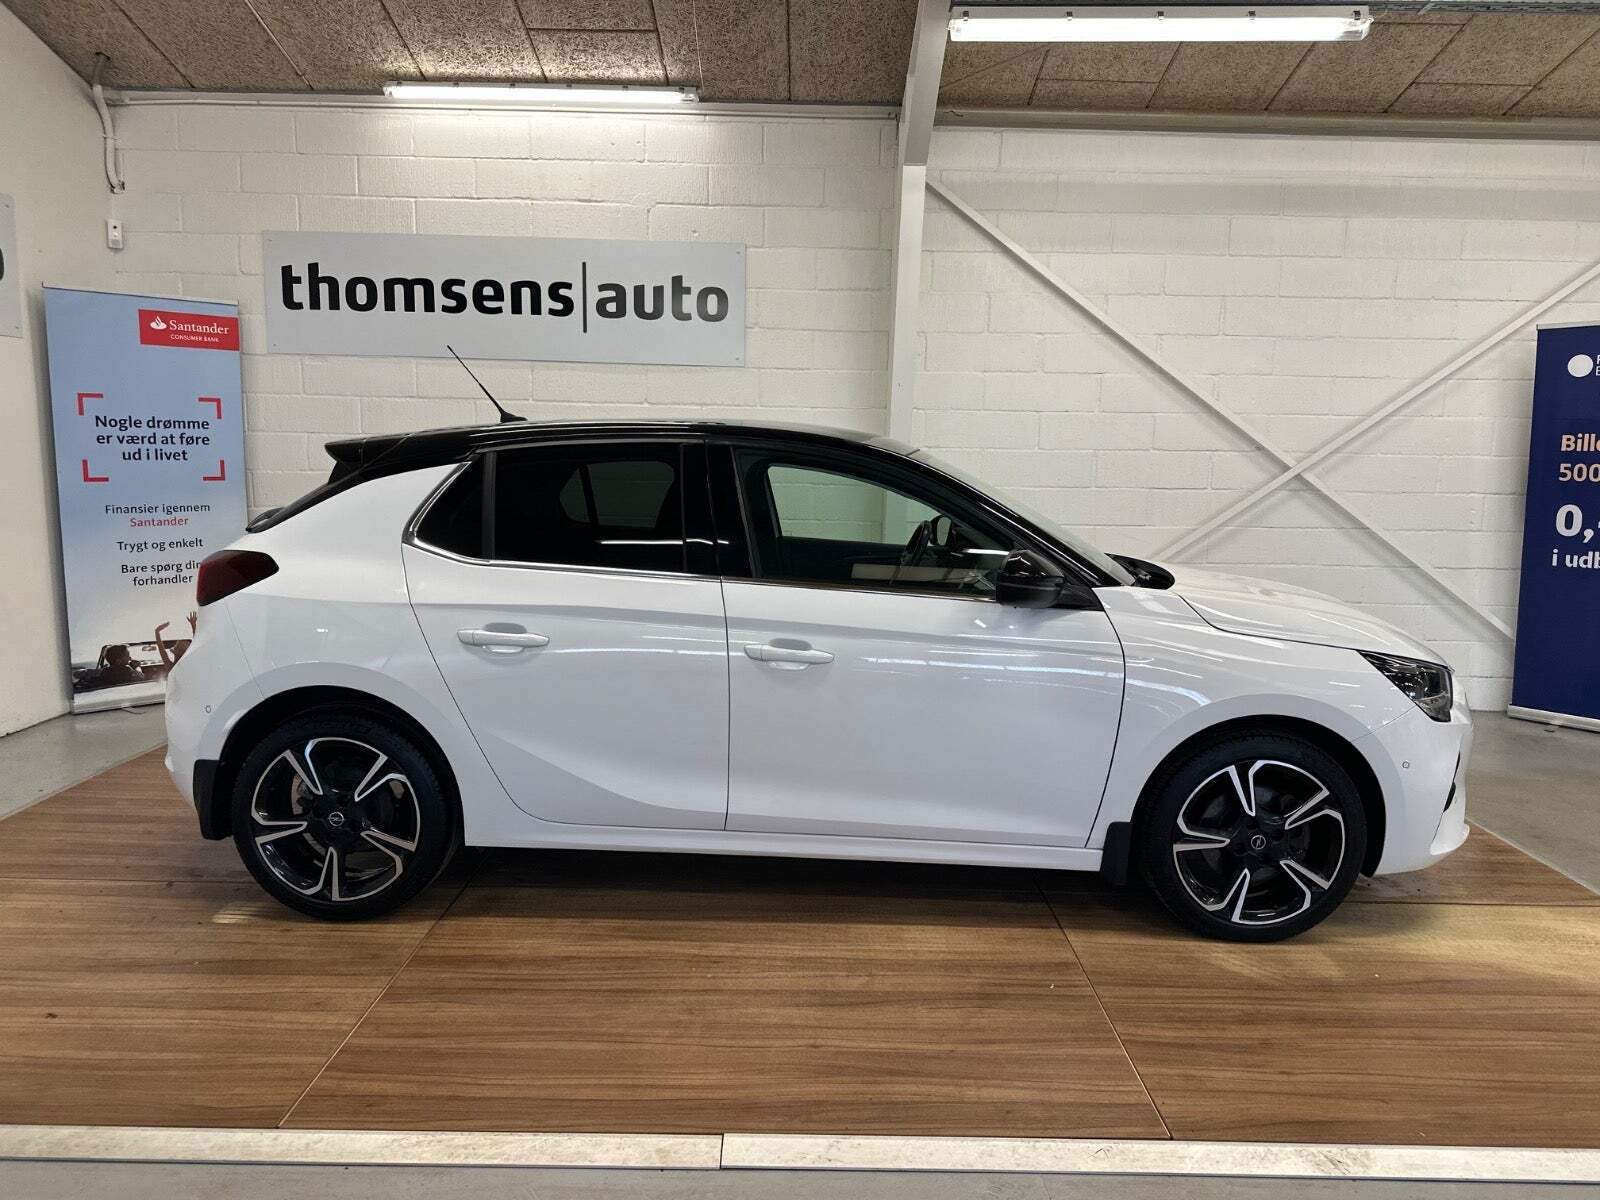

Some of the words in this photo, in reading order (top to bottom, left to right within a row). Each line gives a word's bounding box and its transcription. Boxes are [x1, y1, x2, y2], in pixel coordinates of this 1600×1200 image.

[169, 319, 230, 335] Santander
[170, 334, 202, 342] CONSUMER
[95, 415, 143, 432] Nogle
[146, 416, 210, 430] drømme
[96, 434, 113, 445] er
[116, 432, 157, 445] værd
[160, 434, 176, 445] at
[179, 432, 210, 446] føre
[122, 448, 142, 461] ud
[146, 448, 150, 461] i
[154, 448, 189, 461] livet
[105, 504, 160, 515] Finansier
[162, 503, 211, 516] igennem
[130, 517, 188, 528] Santander
[116, 541, 149, 553] Trygt
[151, 541, 166, 552] og
[168, 537, 204, 549] enkelt
[1552, 548, 1559, 567] i
[121, 564, 148, 574] Bare
[150, 562, 183, 573] spørg
[133, 574, 193, 587] forhandler
